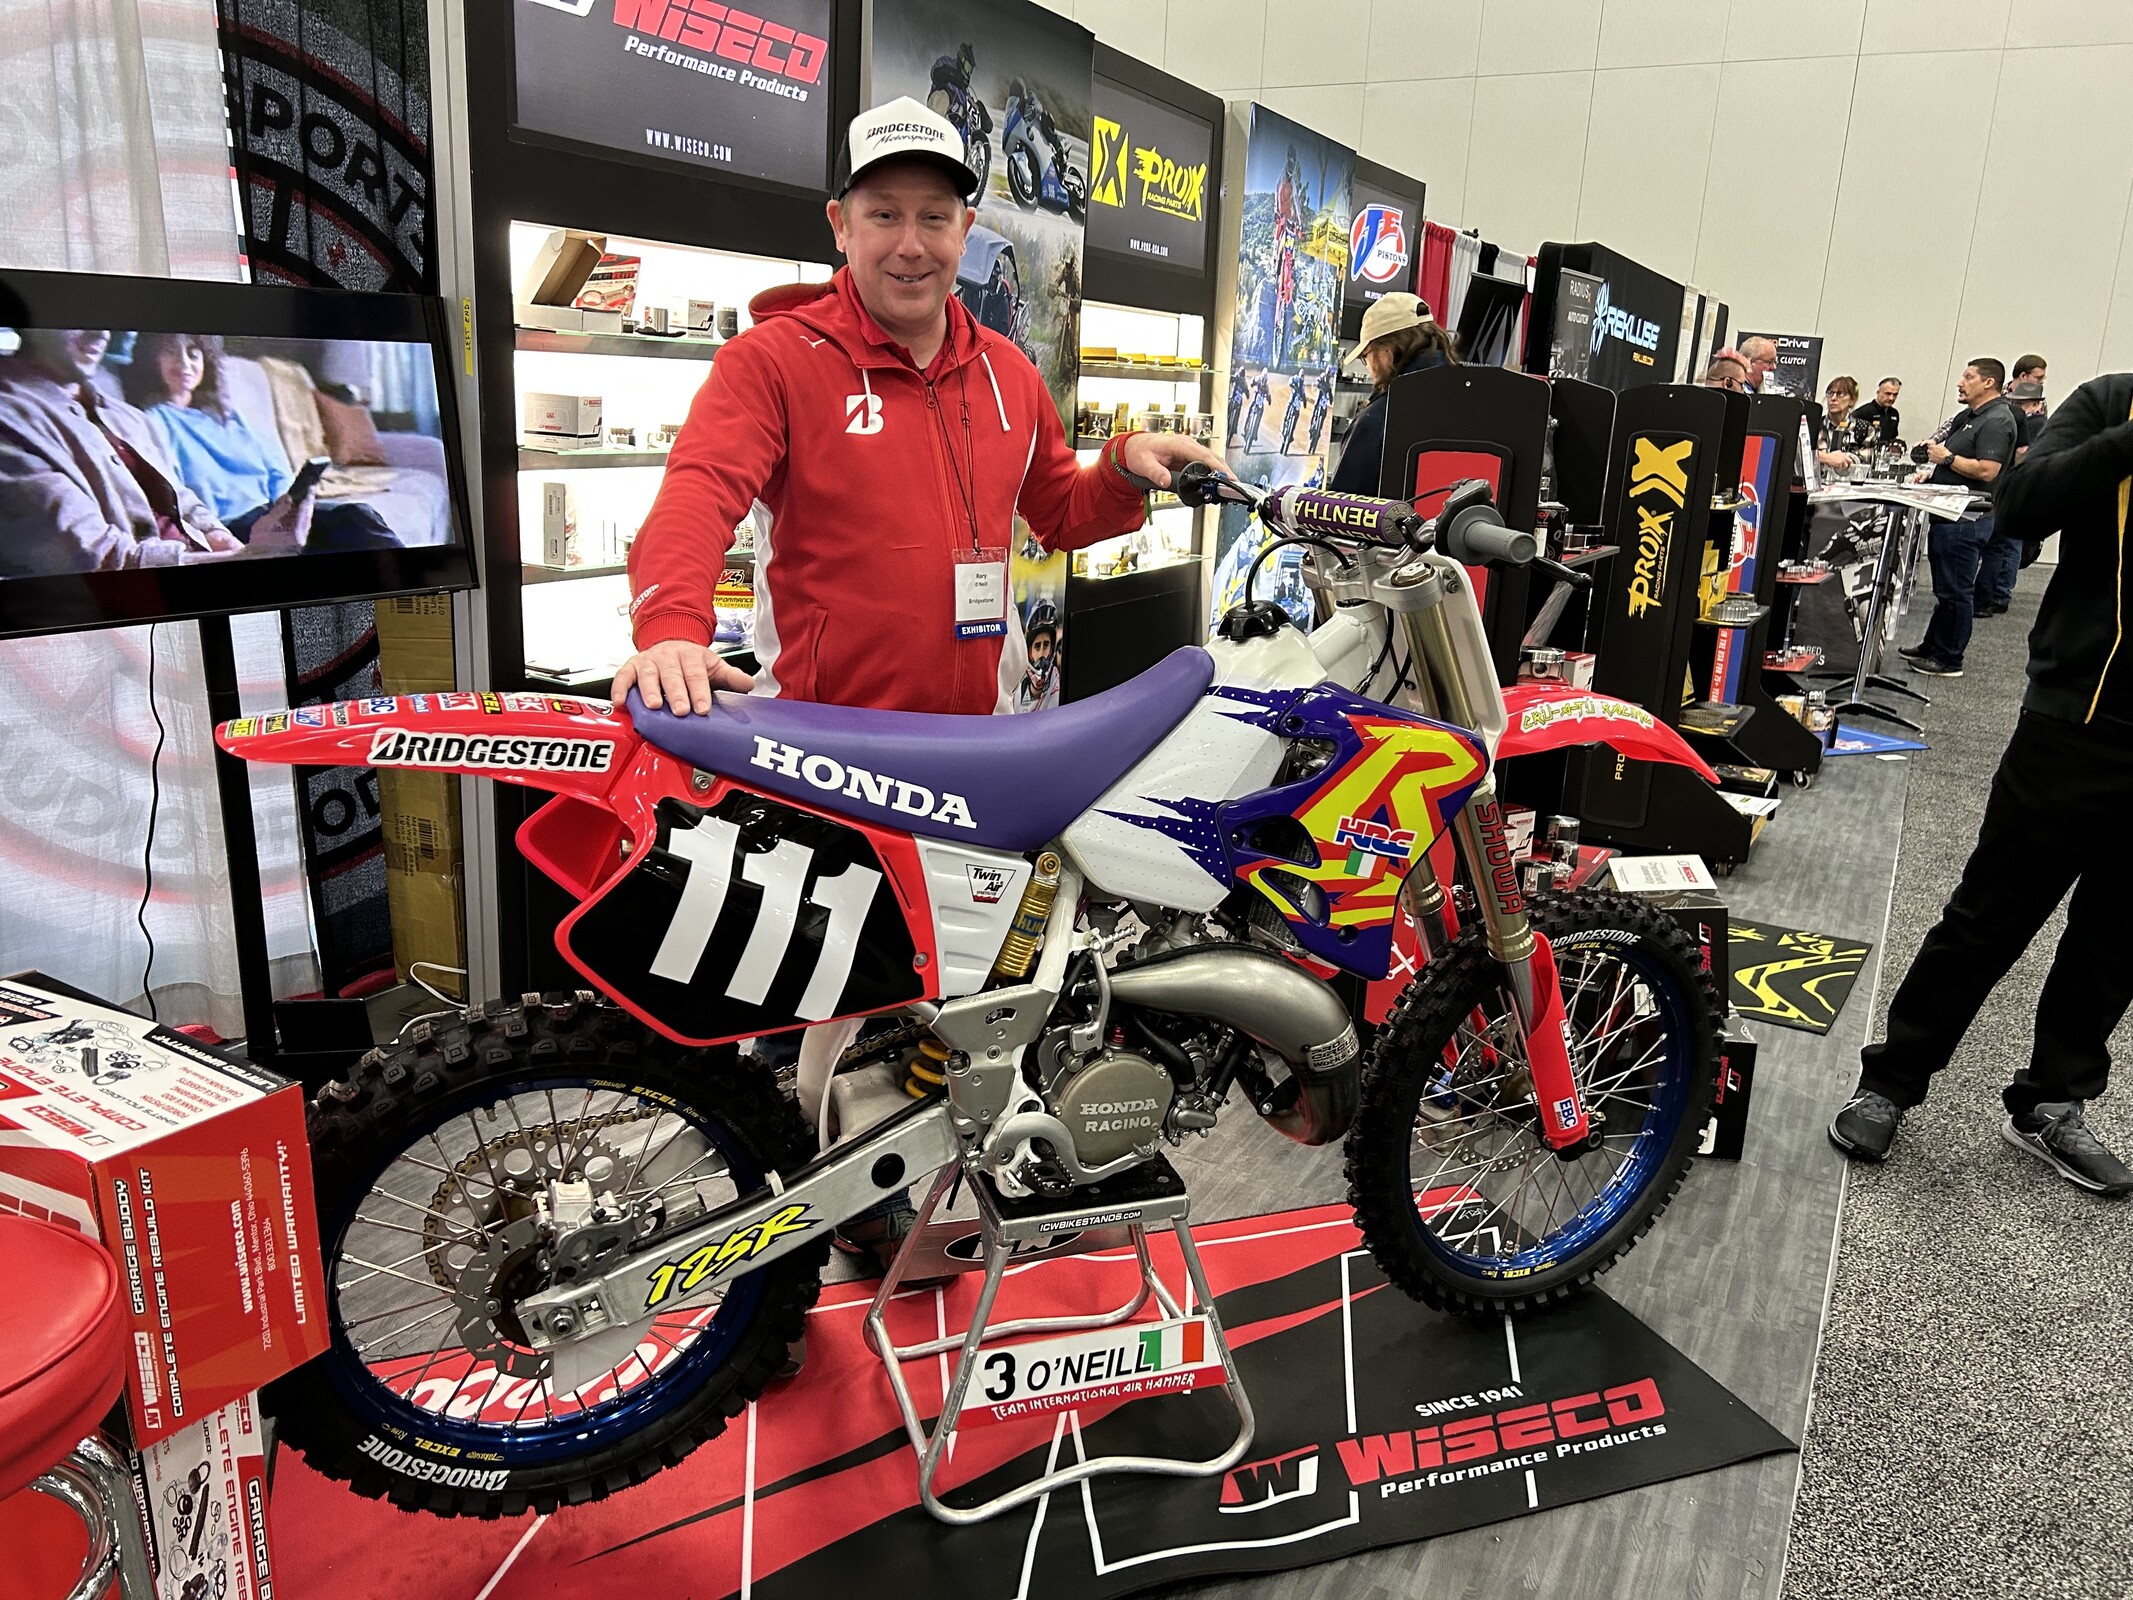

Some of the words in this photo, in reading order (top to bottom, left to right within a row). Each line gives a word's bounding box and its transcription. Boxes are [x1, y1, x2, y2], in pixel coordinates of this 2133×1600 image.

[624, 34, 737, 82] Performance
[739, 69, 809, 103] Products
[645, 127, 733, 163] WWW.WISECO.COM
[866, 122, 946, 142] BRIDGESTONE
[873, 132, 940, 150] Motorsport
[1376, 249, 1407, 265] PISTONS
[1604, 304, 1661, 352] REKLUSE
[1780, 356, 1807, 365] CLUTCH
[1294, 499, 1380, 529] RENTHA
[961, 624, 1002, 635] EXHIBITOR
[1601, 701, 1653, 726] RACING
[372, 732, 612, 769] BRIDGESTONE
[750, 734, 978, 830] HONDA
[1613, 753, 1626, 781] PRO
[1334, 815, 1418, 859] HRC
[1474, 799, 1524, 916] SHOWA
[973, 867, 1002, 881] Twin
[984, 880, 1004, 893] Air
[648, 814, 883, 1022] 111
[1571, 941, 1601, 950] EXCEL
[0, 1057, 54, 1086] ENGINE
[176, 1078, 205, 1093] GASKETS
[206, 1079, 228, 1091] CHAIN
[223, 1065, 278, 1089] LIMITED
[51, 1085, 148, 1131] COMPLETE
[140, 1095, 164, 1109] PISTON
[161, 1092, 177, 1102] ROD
[169, 1086, 200, 1101] BEARING
[181, 1101, 203, 1113] CRANK
[198, 1097, 217, 1108] MAIN
[208, 1090, 231, 1103] SEALS
[227, 1088, 244, 1098] CAM
[631, 1085, 678, 1107] EXCEL
[1079, 1097, 1159, 1116] HONDA
[162, 1106, 189, 1119] FORGED
[1084, 1117, 1151, 1133] RACING
[1560, 1098, 1576, 1129] EBC
[139, 1169, 153, 1194] KIT
[240, 1148, 254, 1200] 44060-5396
[115, 1180, 134, 1240] BUDDY
[246, 1202, 256, 1220] Ohio
[1039, 1209, 1142, 1233] ICWBIKESTANDS.COM
[144, 1199, 163, 1267] REBUILD
[250, 1221, 260, 1251] Mentor,
[264, 1218, 276, 1271] 800.321.1364
[231, 1200, 253, 1313] www.wiseco.com
[645, 1205, 812, 1307] 125R
[126, 1244, 145, 1313] GARAGE
[254, 1275, 265, 1293] Park
[290, 1254, 306, 1324] LIMITED
[155, 1271, 172, 1328] ENGINE
[259, 1295, 270, 1329] Industrial
[262, 1329, 272, 1350] 7201
[134, 1331, 157, 1405] WISECO
[164, 1333, 184, 1416] COMPLETE
[984, 1352, 1017, 1402] 3
[1027, 1341, 1153, 1392] O'NEILL
[991, 1401, 1028, 1421] TEAM
[1029, 1385, 1122, 1411] INTERNATIONAL
[1122, 1380, 1144, 1395] AIR
[1145, 1373, 1196, 1391] HAMMER
[1414, 1394, 1480, 1418] SINCE
[1478, 1384, 1525, 1406] 1941
[1334, 1376, 1667, 1487] WISECO
[414, 1436, 462, 1458] EXCEL
[1380, 1449, 1549, 1499] Performance
[1556, 1422, 1668, 1458] Products
[356, 1434, 511, 1491] BRIDGESTONE
[226, 1479, 242, 1556] ENGINE
[248, 1479, 270, 1580] GARAGE
